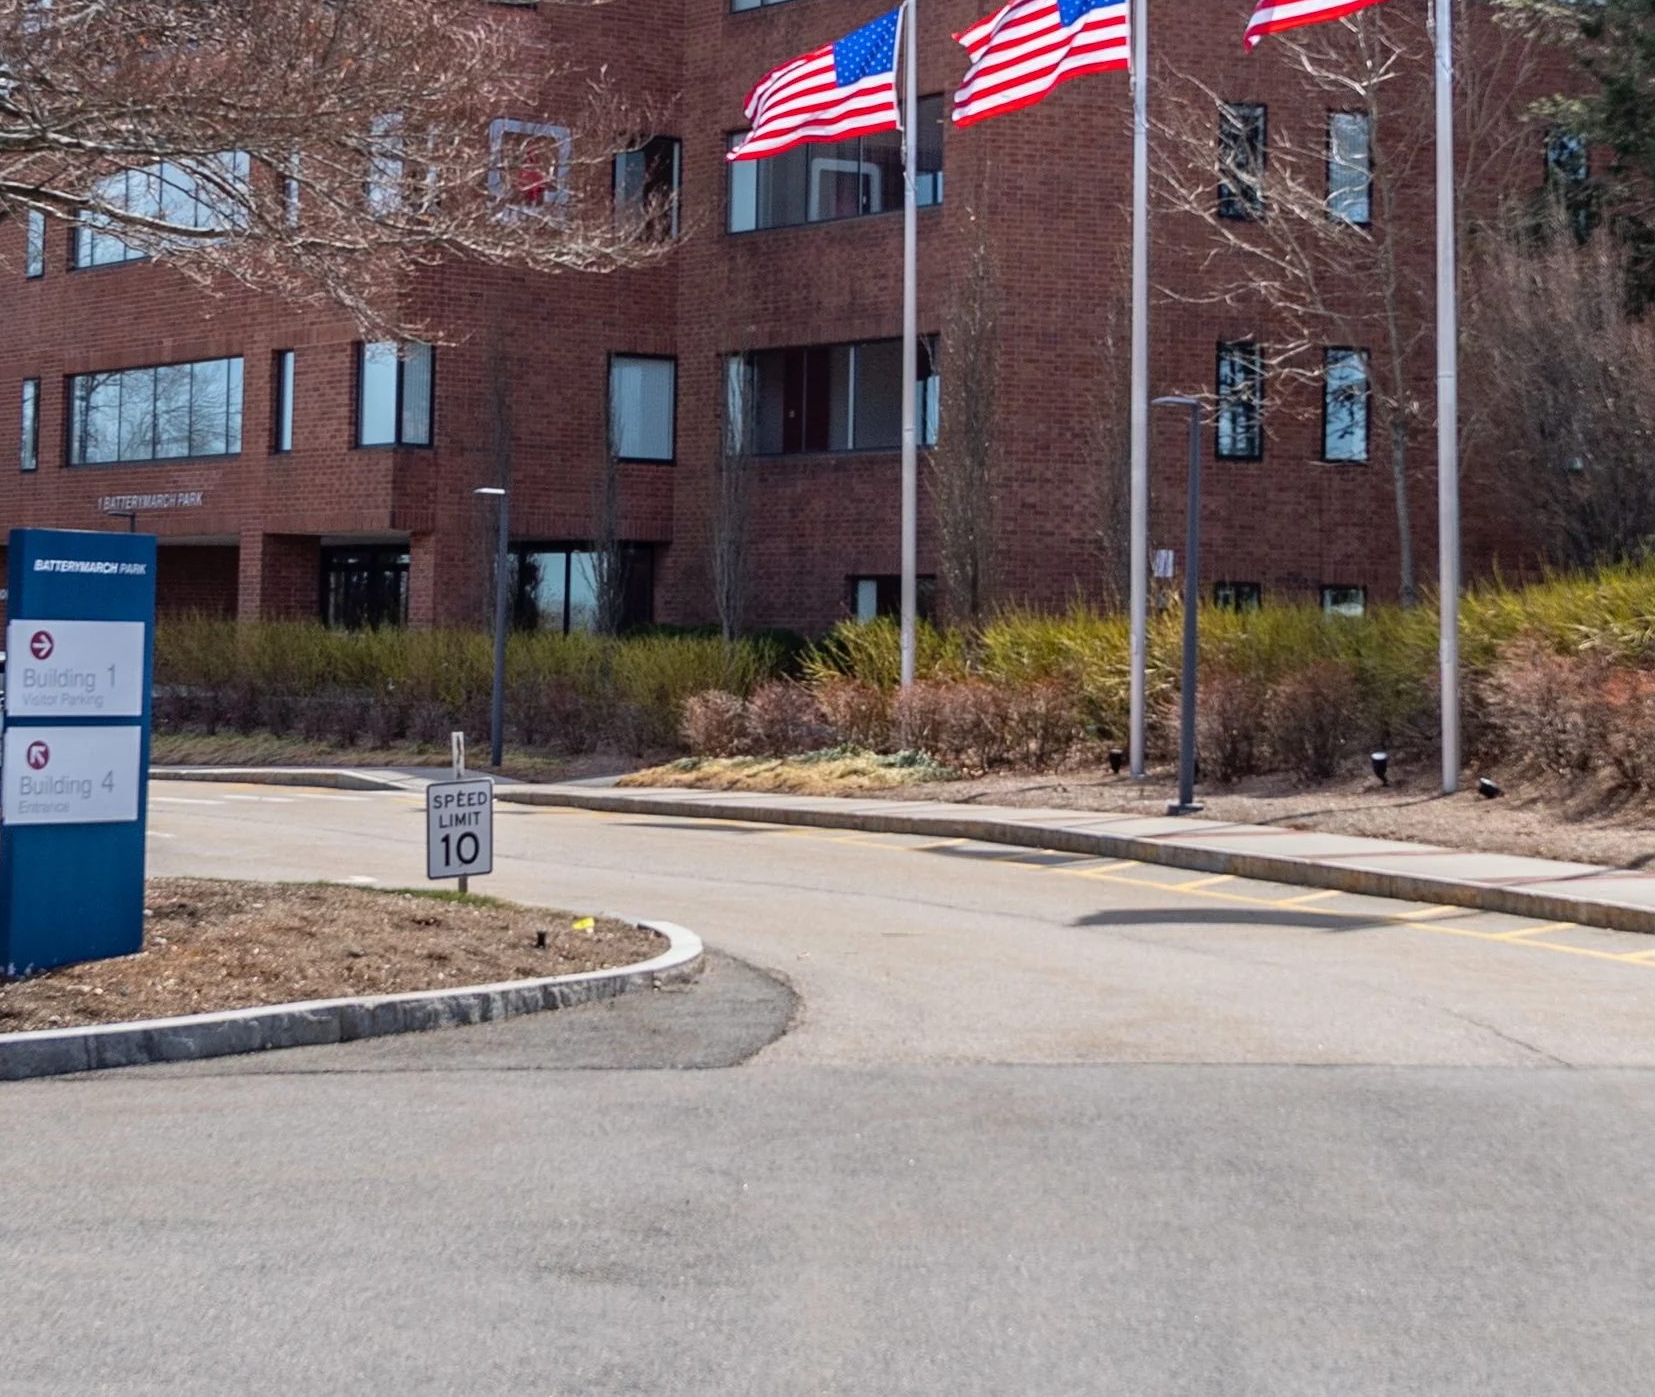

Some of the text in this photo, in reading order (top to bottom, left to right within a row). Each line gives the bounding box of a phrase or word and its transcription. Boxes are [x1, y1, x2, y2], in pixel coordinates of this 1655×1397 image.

[178, 491, 203, 507] PARK
[34, 559, 146, 575] BATTERYMARCH PARK
[23, 663, 116, 693] Building 1
[61, 693, 104, 709] Parking
[20, 769, 114, 800] Building 4
[18, 800, 70, 815] Entrance
[433, 791, 488, 809] SPEED
[439, 811, 482, 829] LIMIT
[441, 831, 480, 867] 10
